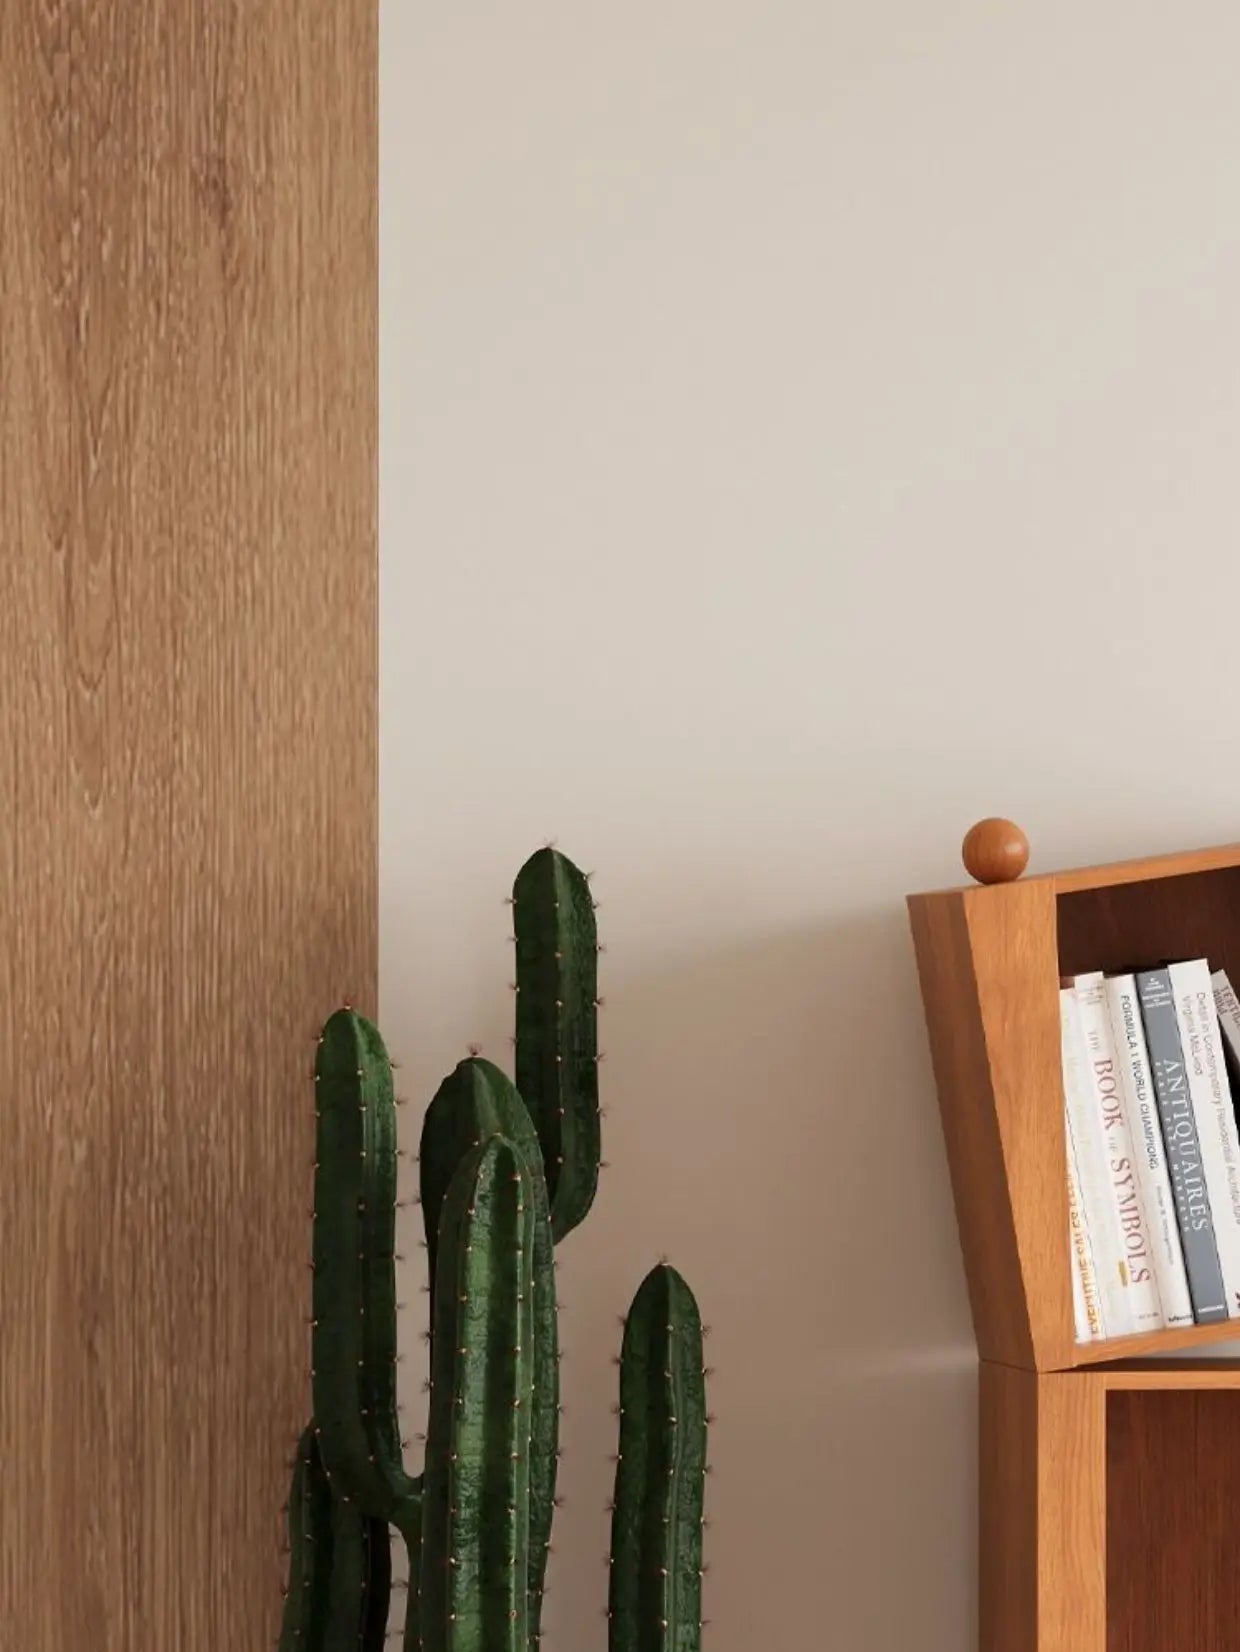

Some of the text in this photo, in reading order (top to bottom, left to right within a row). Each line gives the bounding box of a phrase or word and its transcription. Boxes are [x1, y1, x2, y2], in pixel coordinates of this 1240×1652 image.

[1121, 995, 1138, 1049] FORMULA
[1131, 1060, 1145, 1101] WORLD
[1139, 1103, 1159, 1169] CHAMPIONS
[1166, 1059, 1208, 1231] ANTIQUAIRES
[1203, 1034, 1222, 1104] Contemporary
[1094, 1059, 1123, 1130] BOOK
[1112, 1158, 1151, 1283] SYMBOLS
